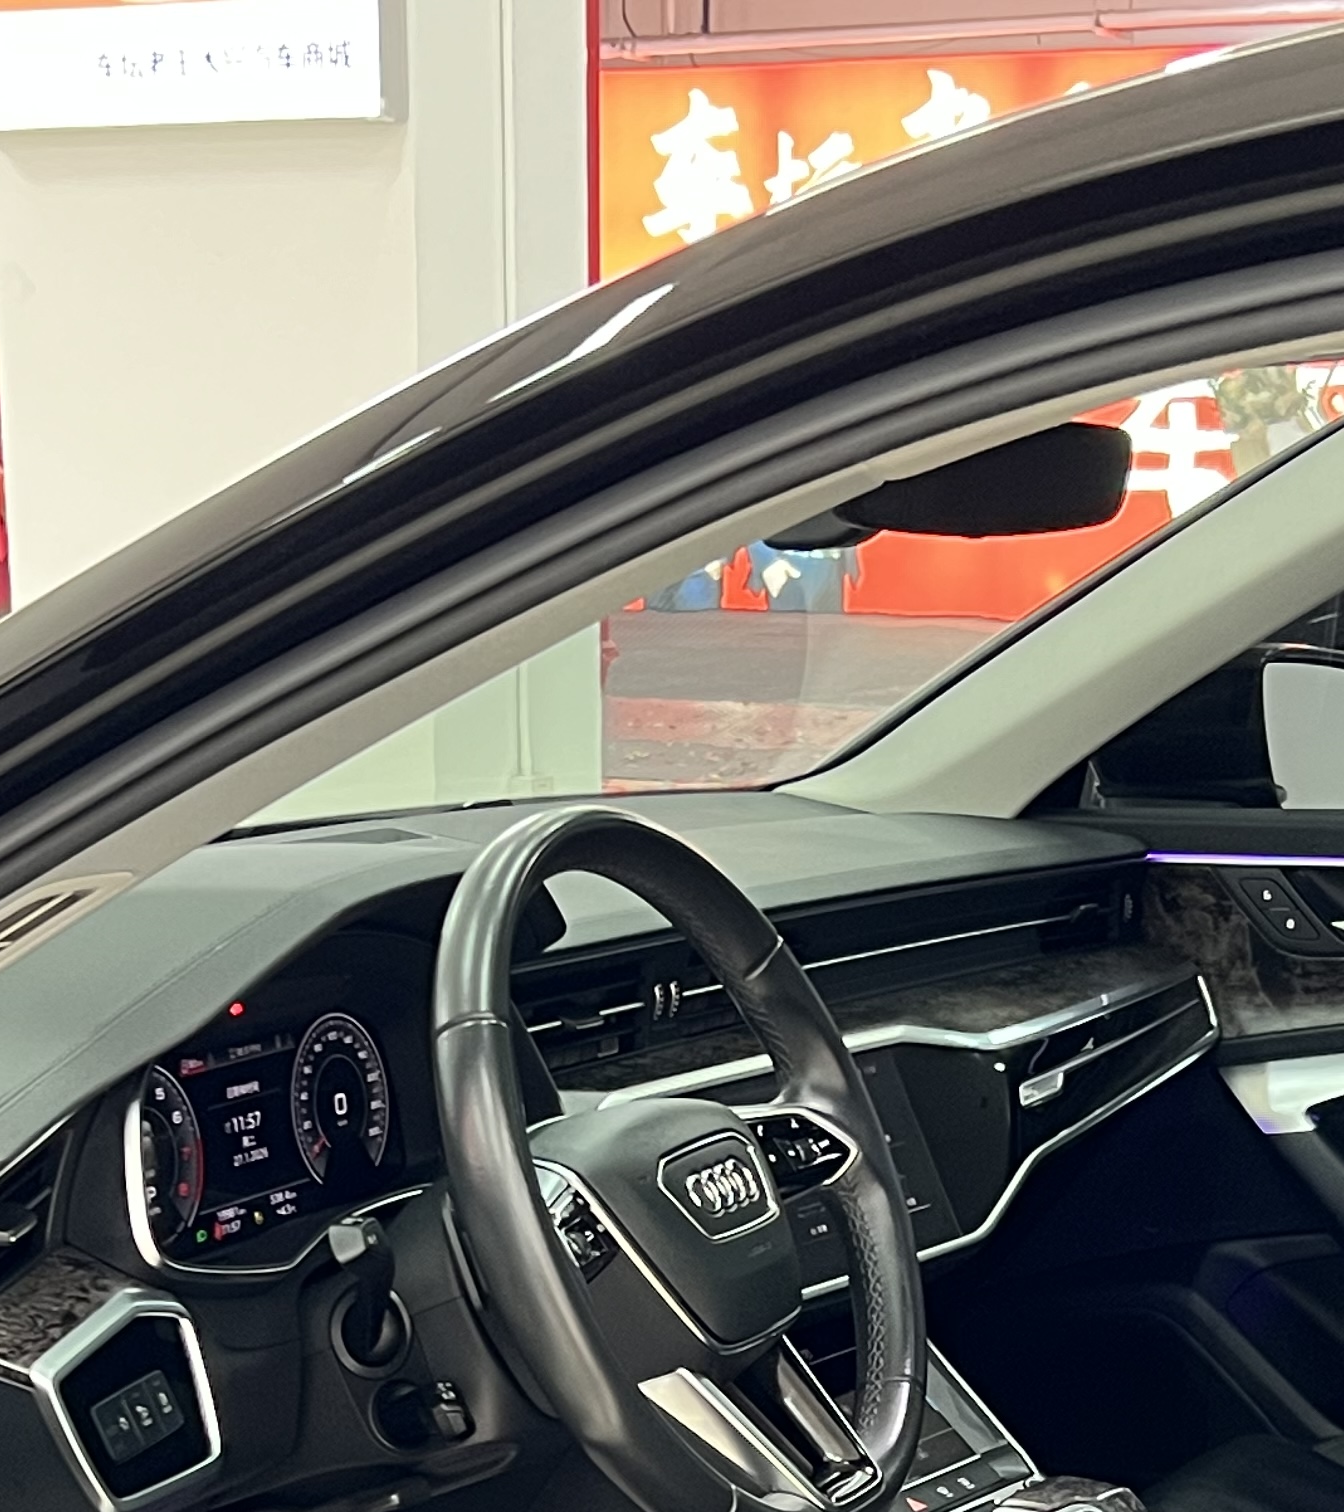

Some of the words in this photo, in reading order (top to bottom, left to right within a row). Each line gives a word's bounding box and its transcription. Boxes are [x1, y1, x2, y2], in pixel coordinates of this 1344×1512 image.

[154, 1087, 166, 1101] 5
[334, 1093, 348, 1115] 0
[171, 1110, 183, 1124] 6
